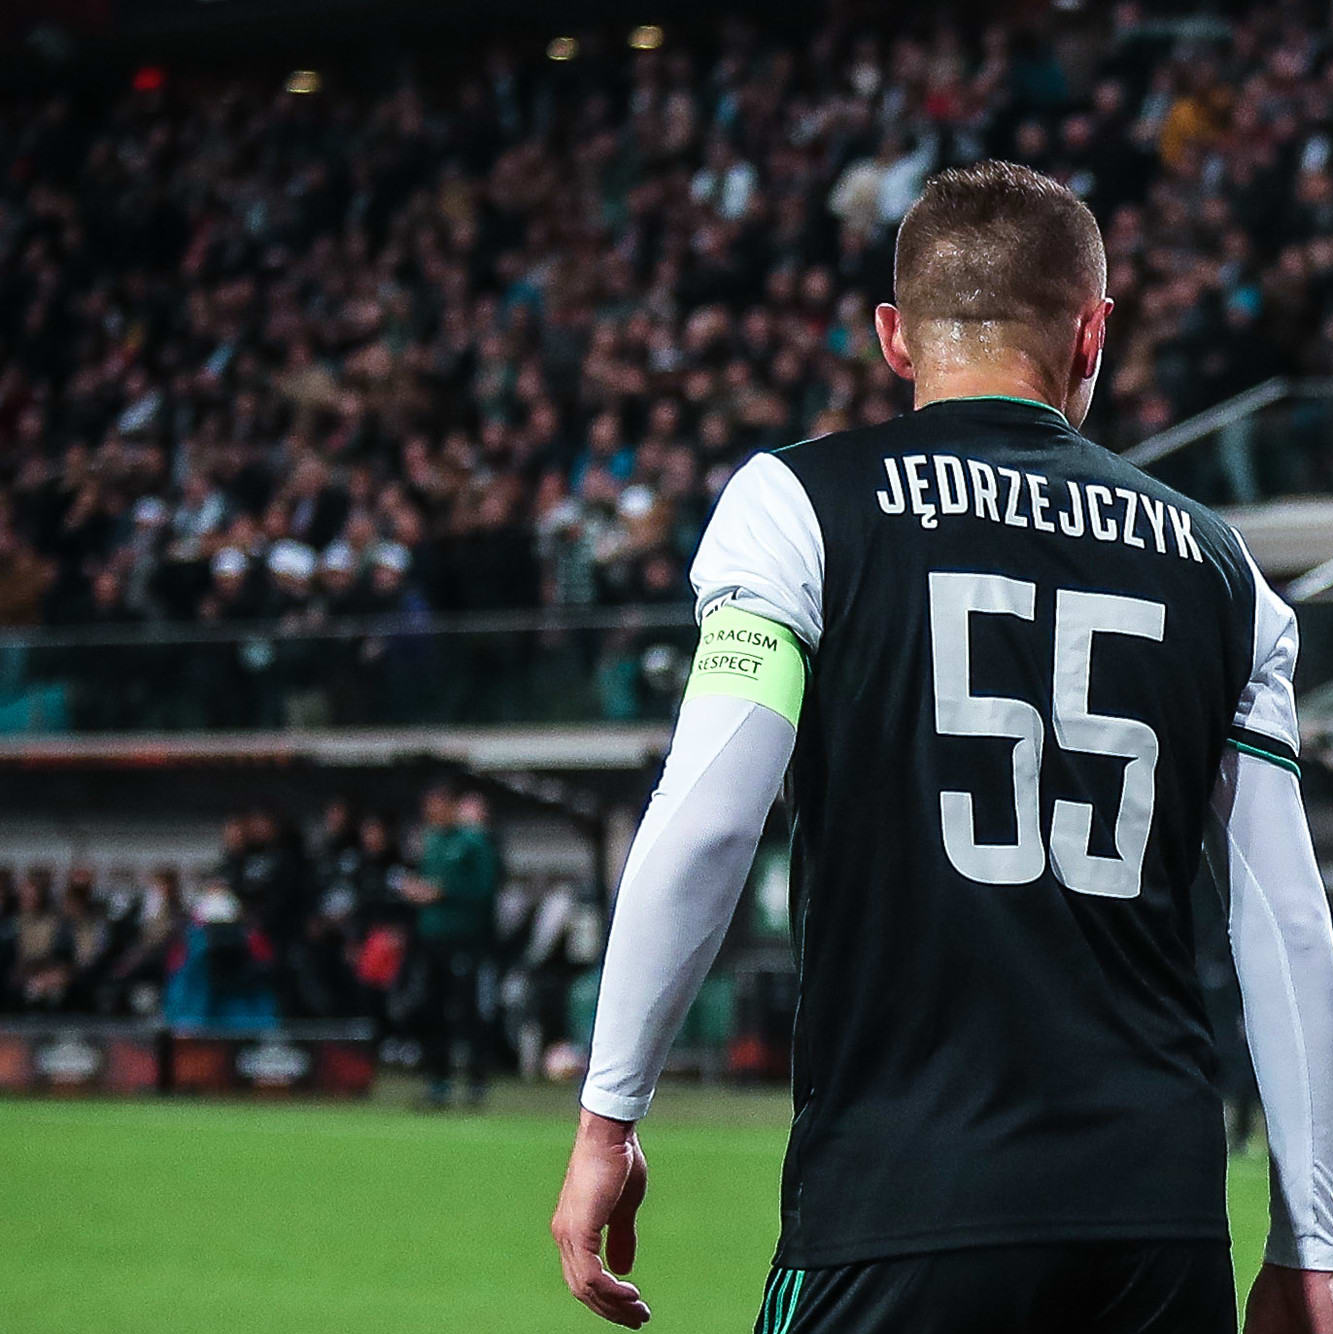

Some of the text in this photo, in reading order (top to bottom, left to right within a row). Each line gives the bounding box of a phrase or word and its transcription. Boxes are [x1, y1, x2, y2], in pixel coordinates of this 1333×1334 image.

[876, 455, 1203, 563] JĘDRZEJCZYK
[717, 629, 778, 652] RACISM
[928, 571, 1166, 899] 55
